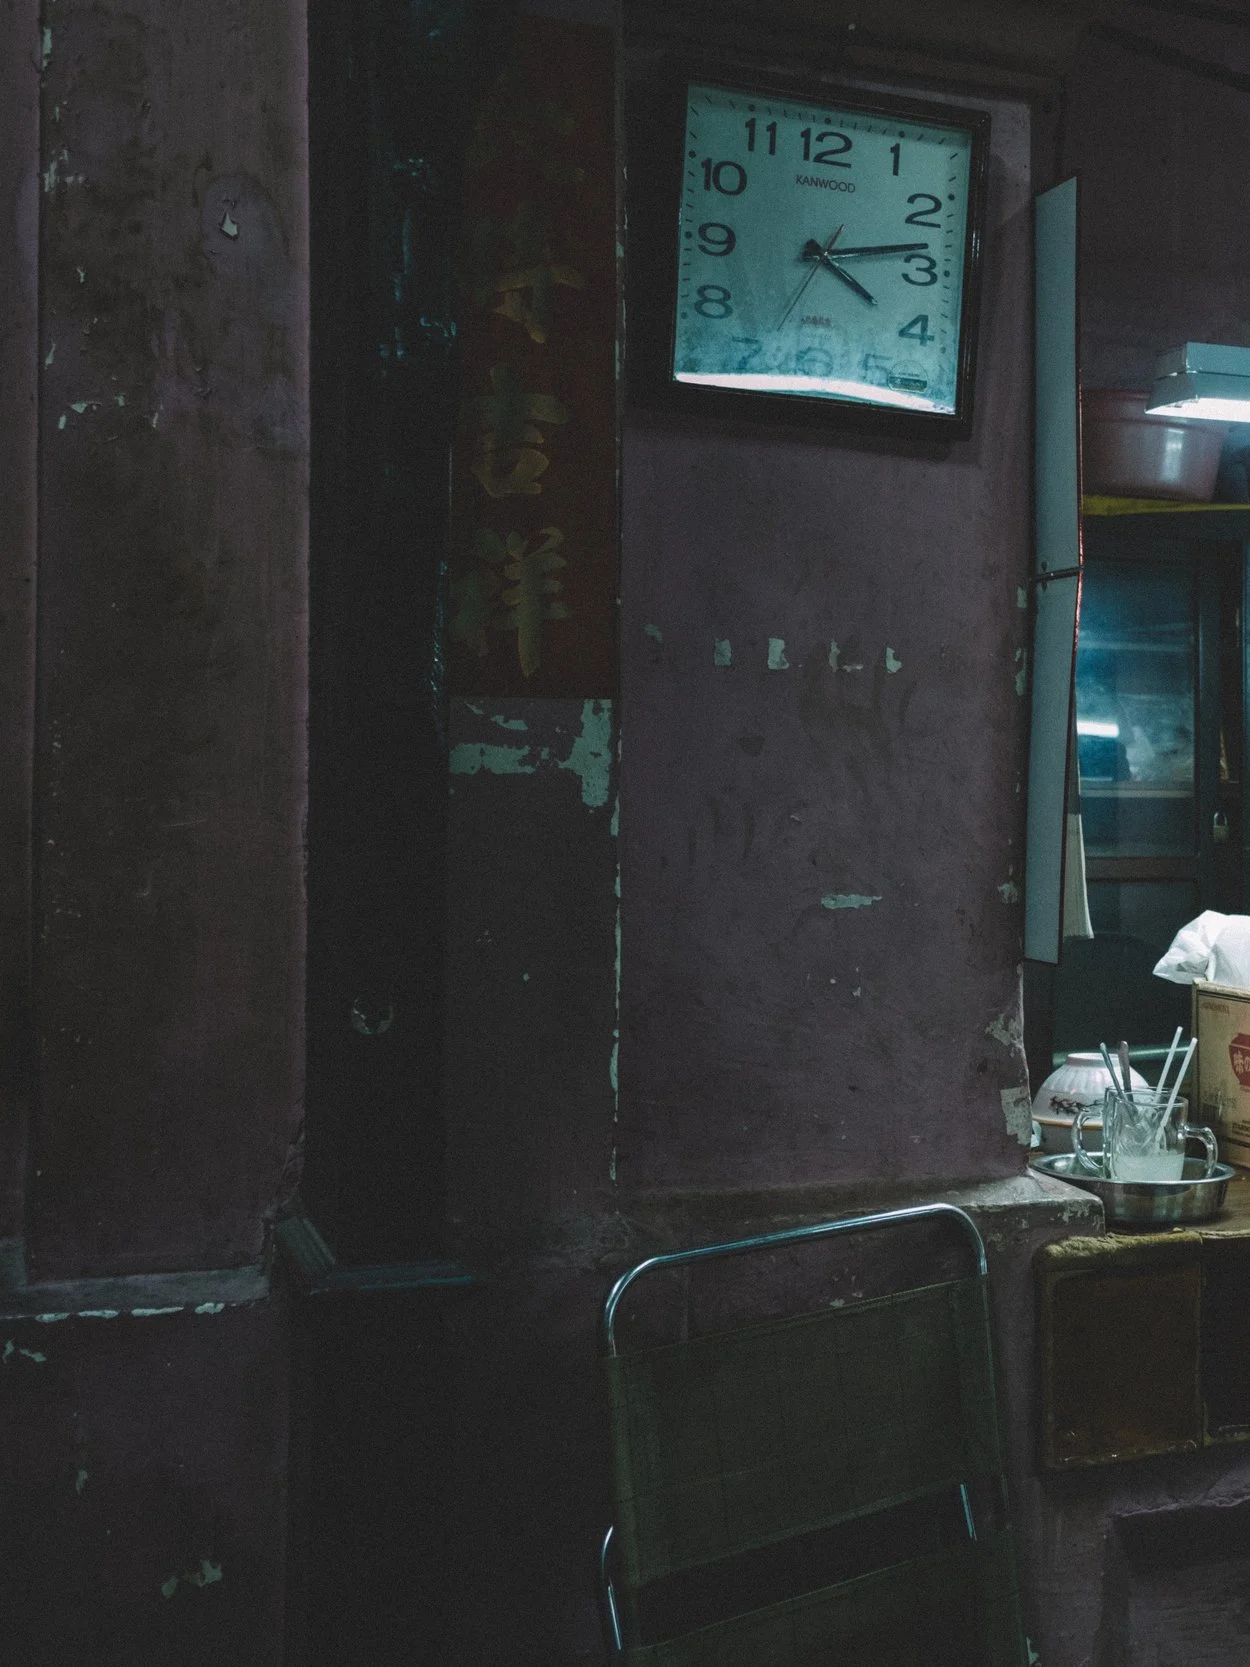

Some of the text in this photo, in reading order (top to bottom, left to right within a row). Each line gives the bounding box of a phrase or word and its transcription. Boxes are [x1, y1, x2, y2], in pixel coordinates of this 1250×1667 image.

[744, 117, 777, 156] 11
[800, 127, 853, 169] 12
[701, 157, 748, 196] 10
[889, 142, 901, 177] 1
[795, 174, 856, 194] KANWOOD
[904, 193, 942, 229] 2
[697, 222, 737, 257] 9
[901, 253, 939, 287] 3
[693, 284, 733, 320] 8
[898, 314, 935, 347] 4
[731, 336, 762, 373] 7
[863, 353, 893, 387] 5
